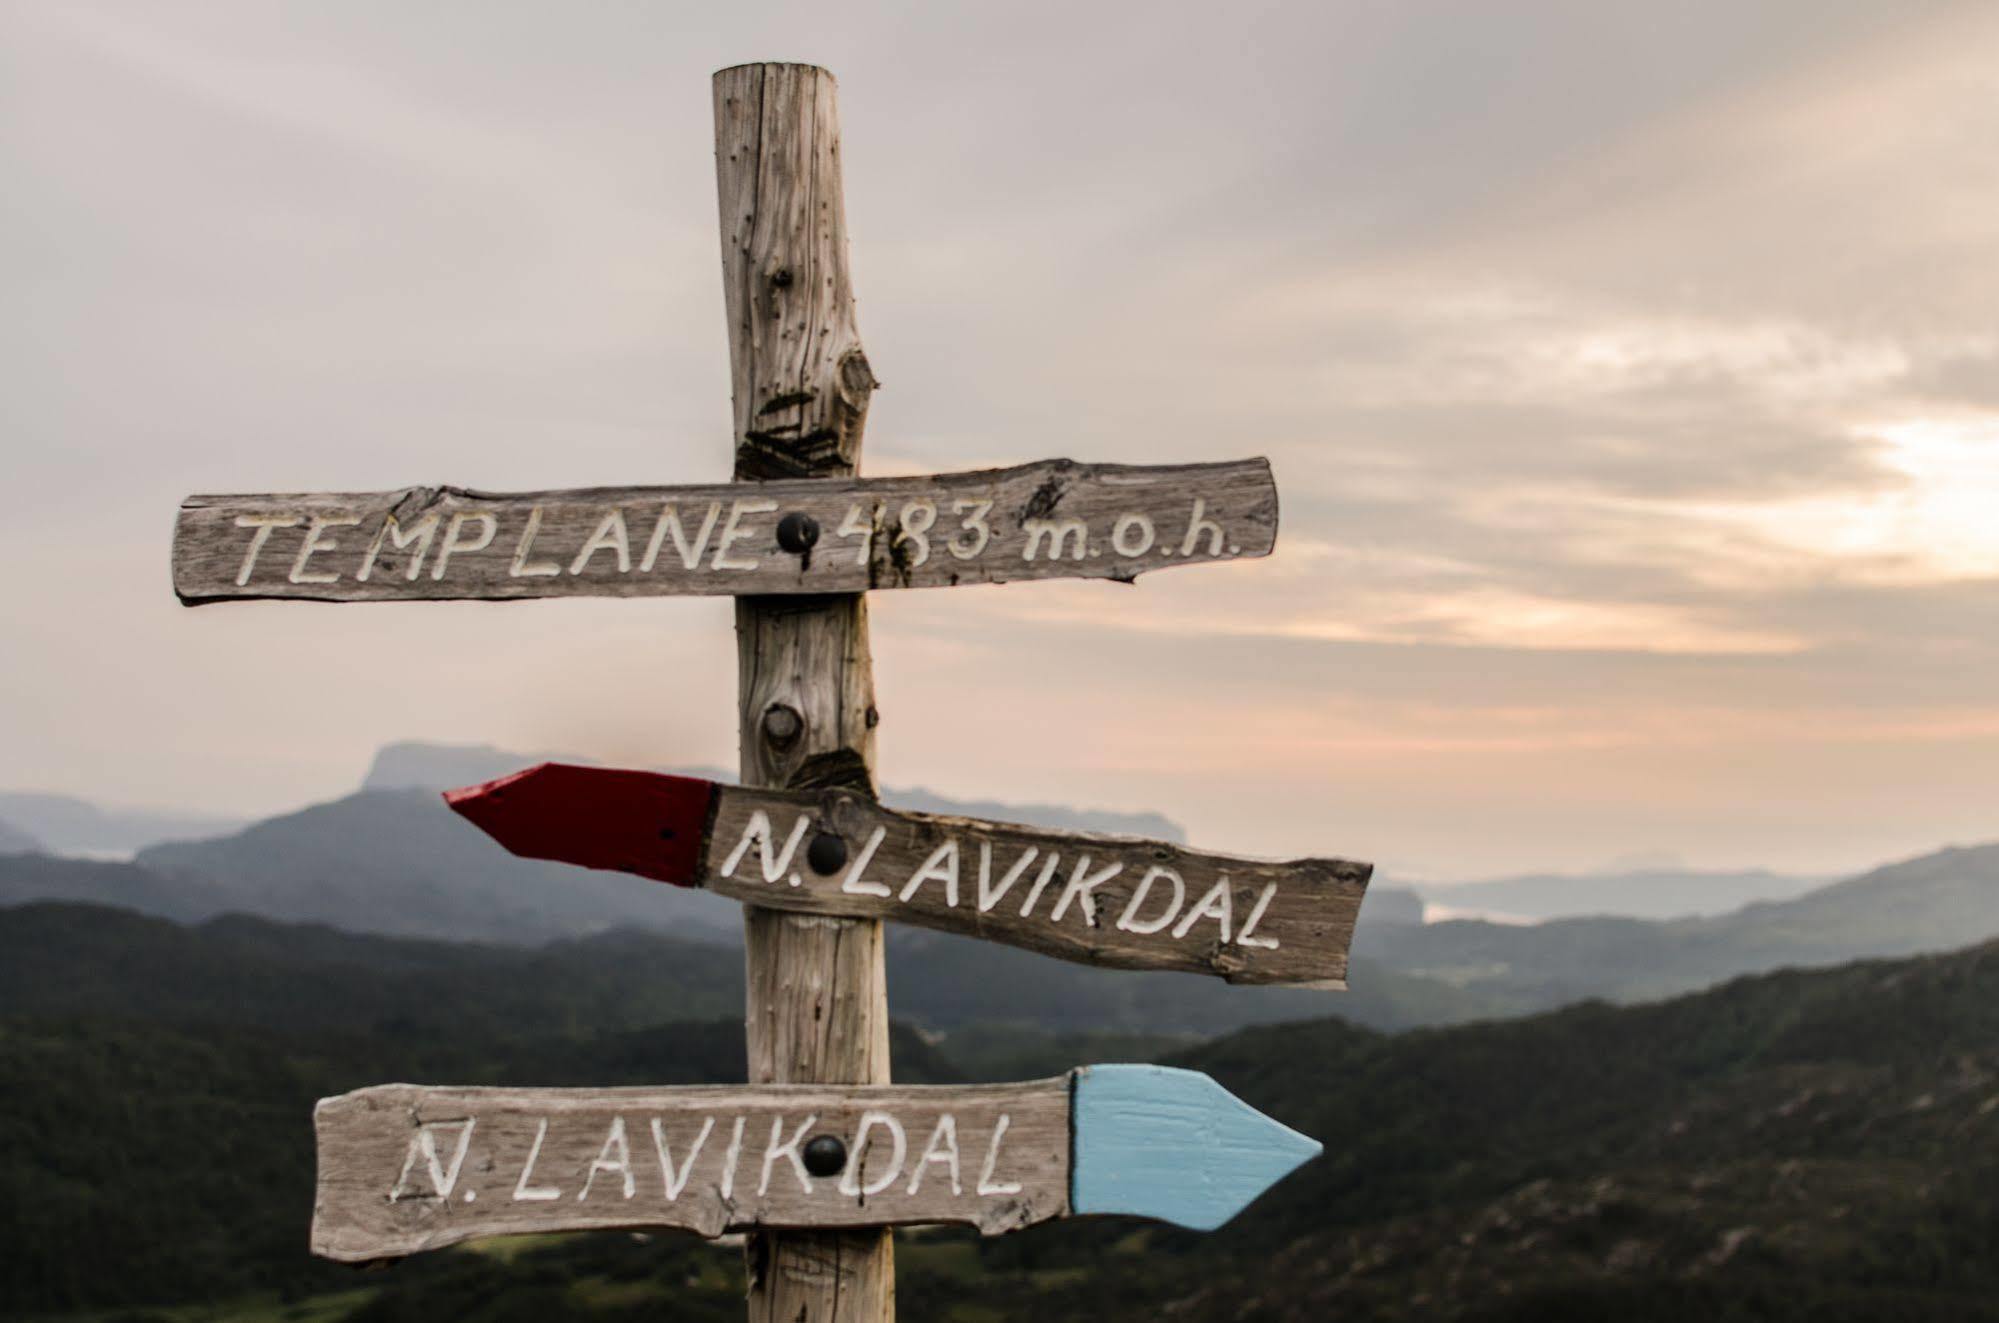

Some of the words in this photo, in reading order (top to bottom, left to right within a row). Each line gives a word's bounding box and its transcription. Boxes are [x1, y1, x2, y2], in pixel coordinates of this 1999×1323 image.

[235, 499, 778, 586] TEMPLANE
[837, 499, 994, 567] 483
[721, 810, 809, 888] N.
[842, 825, 1278, 950] LAVIKDAL
[389, 1116, 476, 1203] N.
[512, 1111, 1022, 1202] LAVIKDAL
